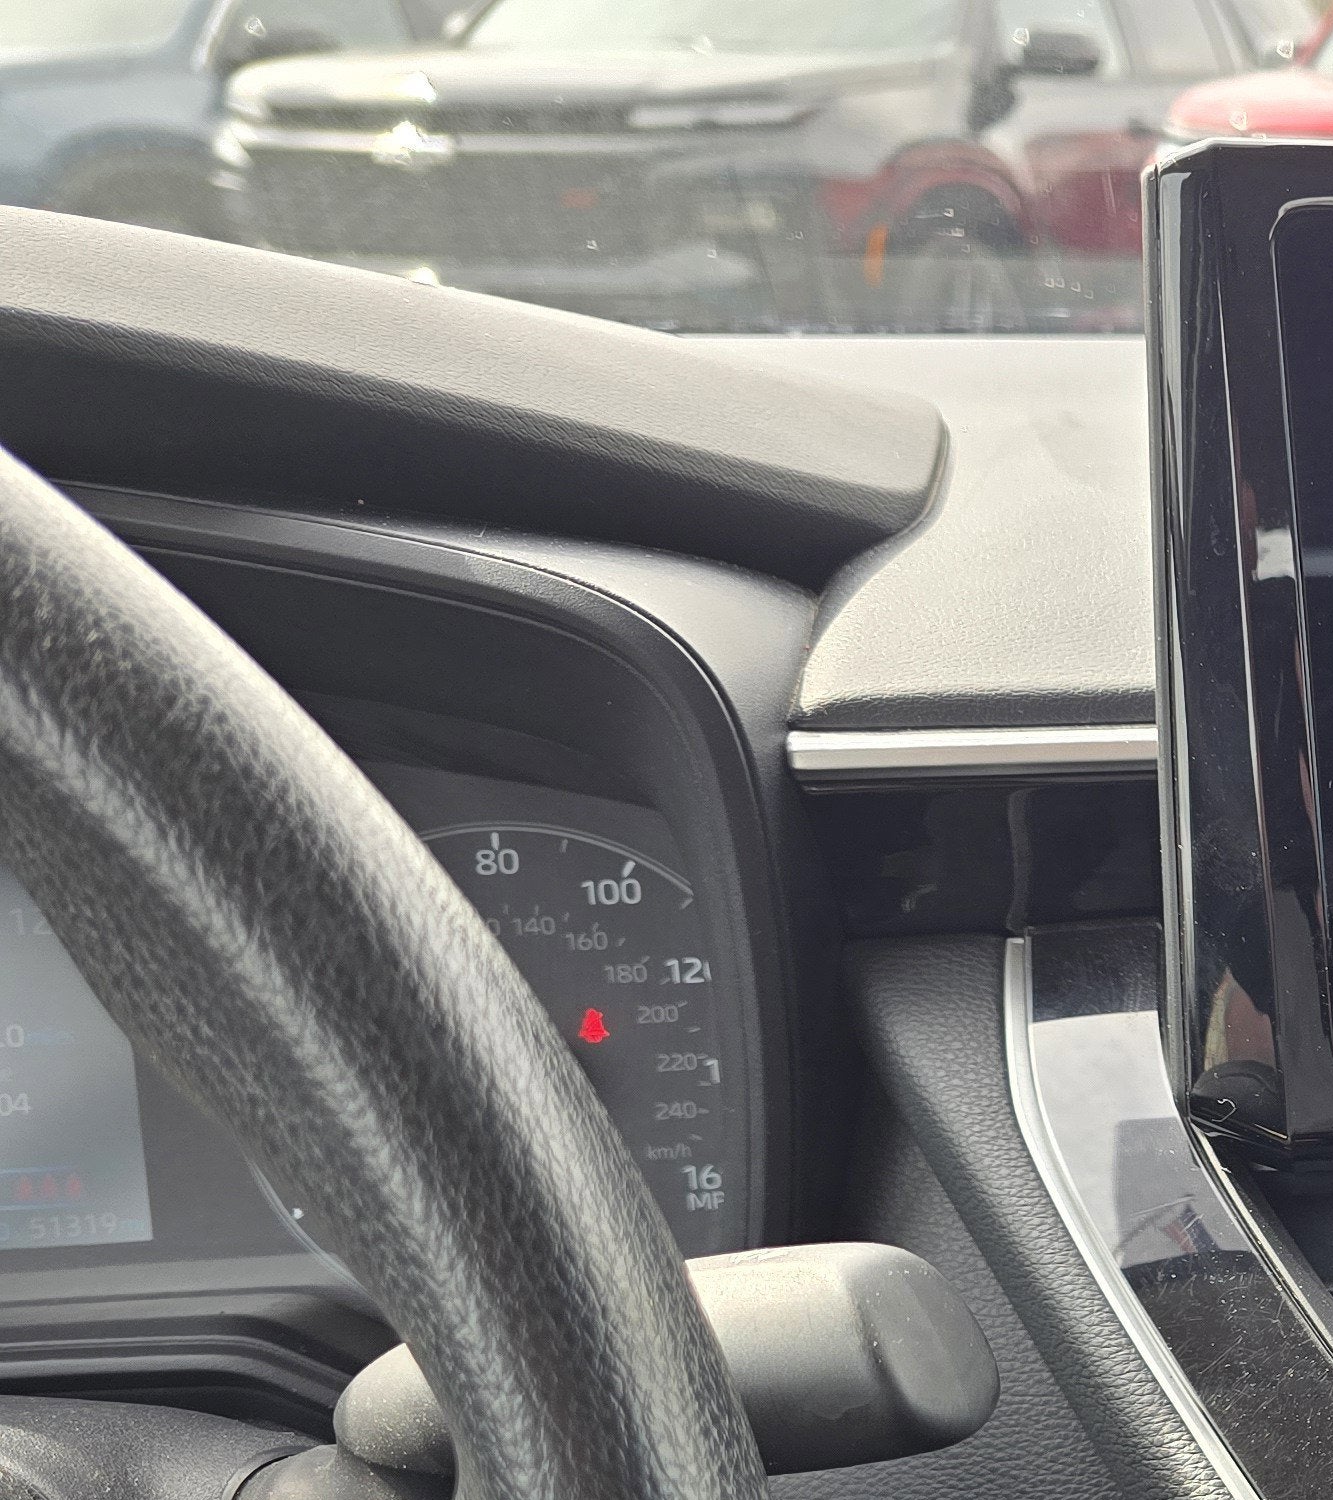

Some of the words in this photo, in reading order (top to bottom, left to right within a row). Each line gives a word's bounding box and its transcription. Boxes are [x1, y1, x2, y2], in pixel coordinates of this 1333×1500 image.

[475, 848, 520, 876] 80
[581, 878, 643, 906] 100
[512, 915, 555, 937] 140
[565, 930, 609, 951] 160
[604, 963, 648, 984] 180
[637, 1004, 679, 1024] 200
[656, 1053, 698, 1072] 220
[654, 1101, 697, 1120] 240
[681, 1164, 723, 1191] 16
